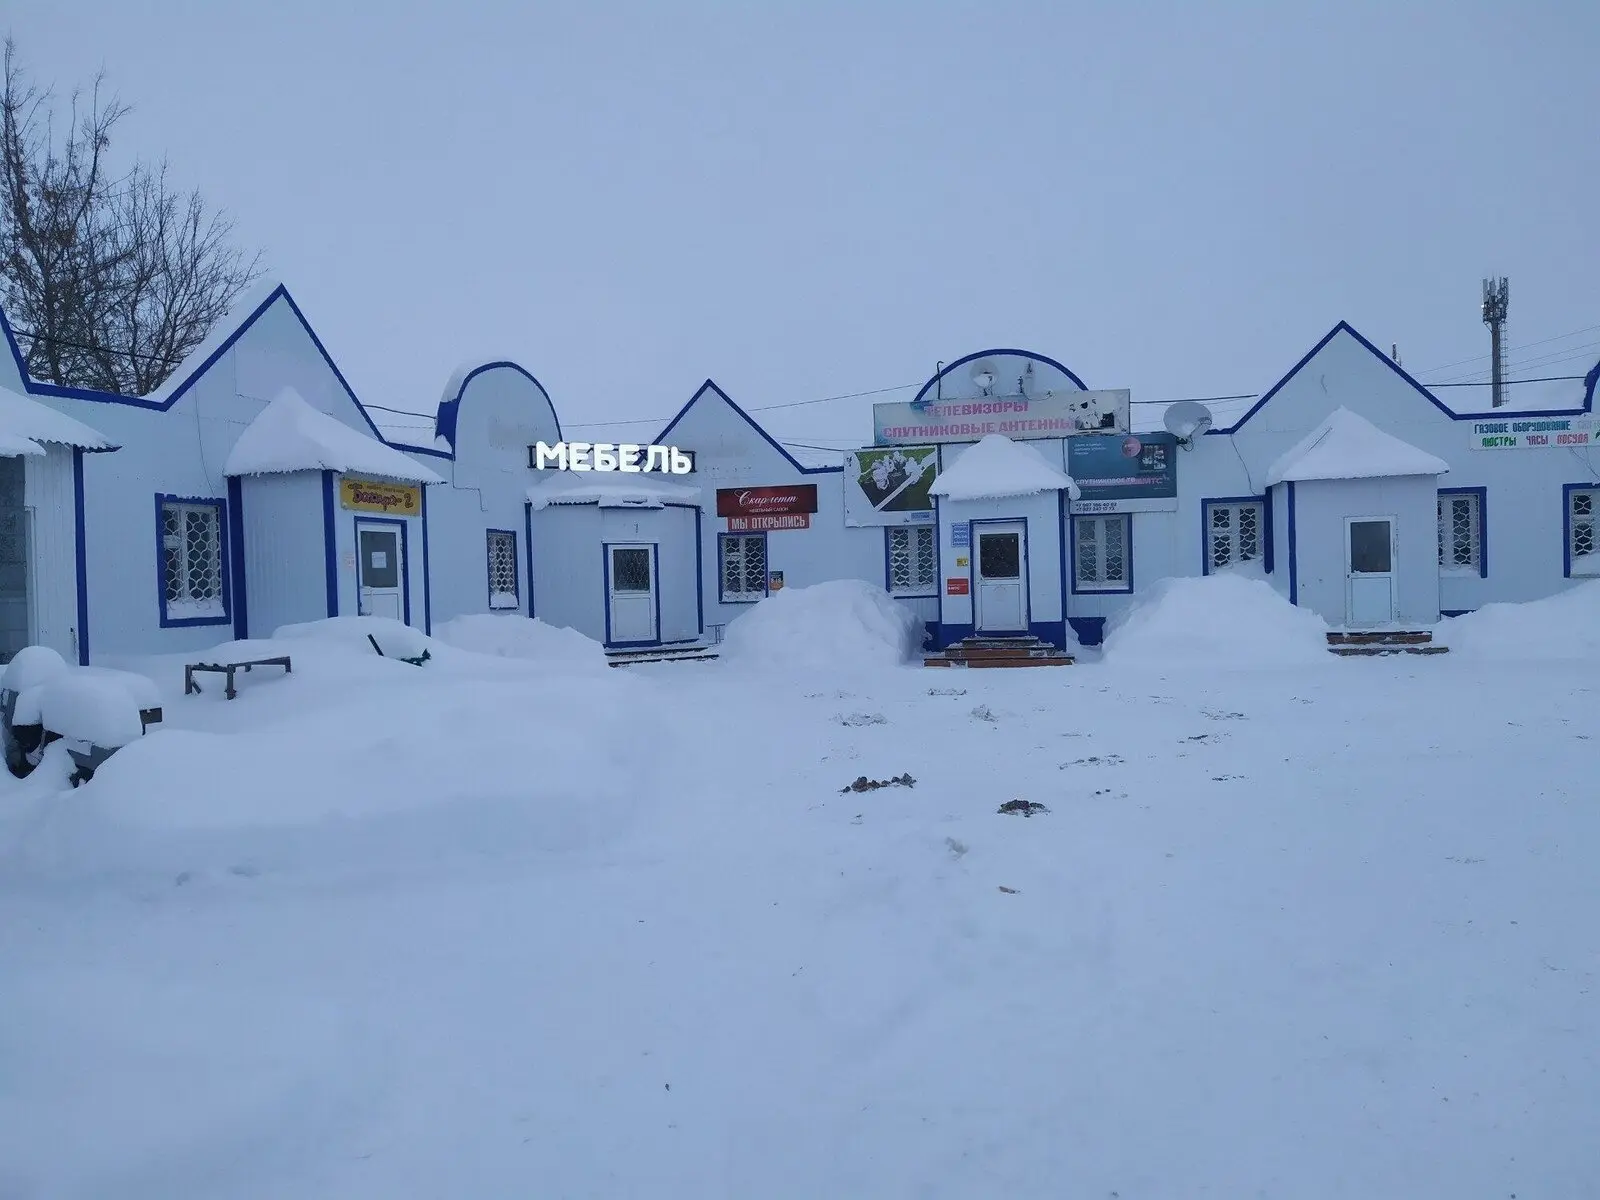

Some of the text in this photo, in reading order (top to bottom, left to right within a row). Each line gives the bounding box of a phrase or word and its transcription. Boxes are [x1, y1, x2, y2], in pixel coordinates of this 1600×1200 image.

[882, 422, 995, 438] СПУТНИКОВЫЕ
[1474, 423, 1509, 434] ГАЗОВОЕ
[1512, 420, 1571, 432] ОБОРУДОВАНИЕ
[1482, 433, 1589, 447] ЛЮСТРЫ ЧАСЫ ПОСУДА
[535, 440, 692, 475] МЕБЕЛЬ
[732, 516, 805, 529] МЫ ОТКРЫЛИСЬ
